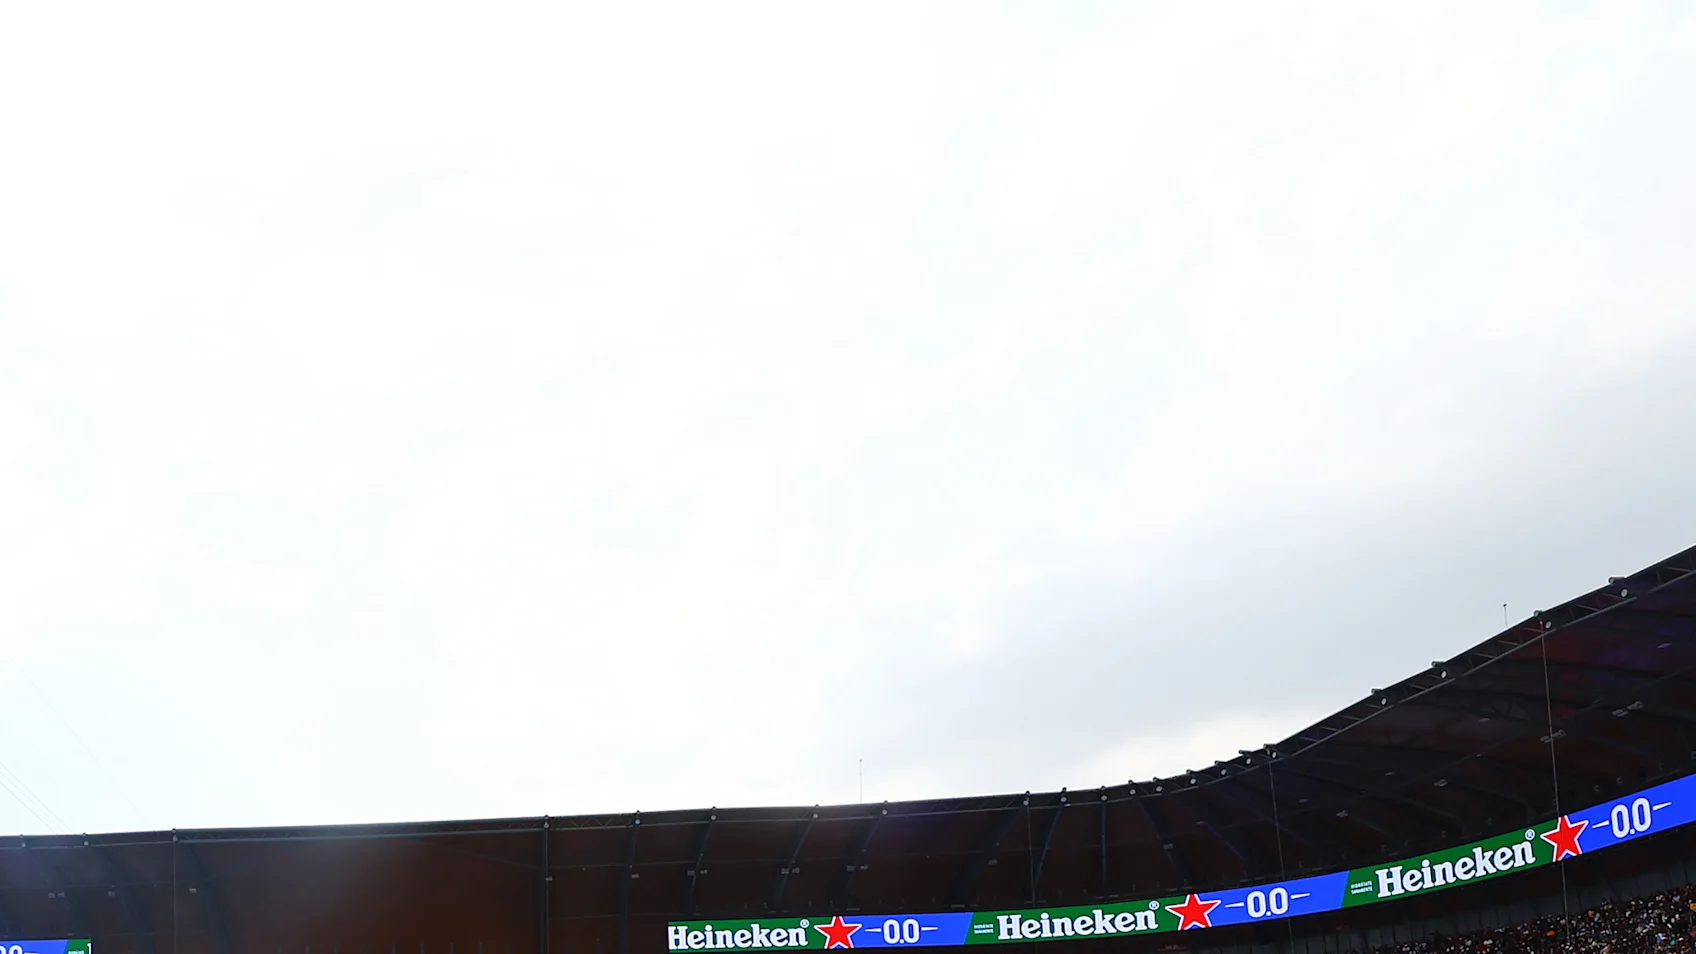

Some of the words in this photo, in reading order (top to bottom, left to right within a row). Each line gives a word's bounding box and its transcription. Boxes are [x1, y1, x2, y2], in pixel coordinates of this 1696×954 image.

[1611, 798, 1652, 838] 0.0
[1247, 887, 1289, 918] 0.0
[883, 919, 920, 944] 0.0
